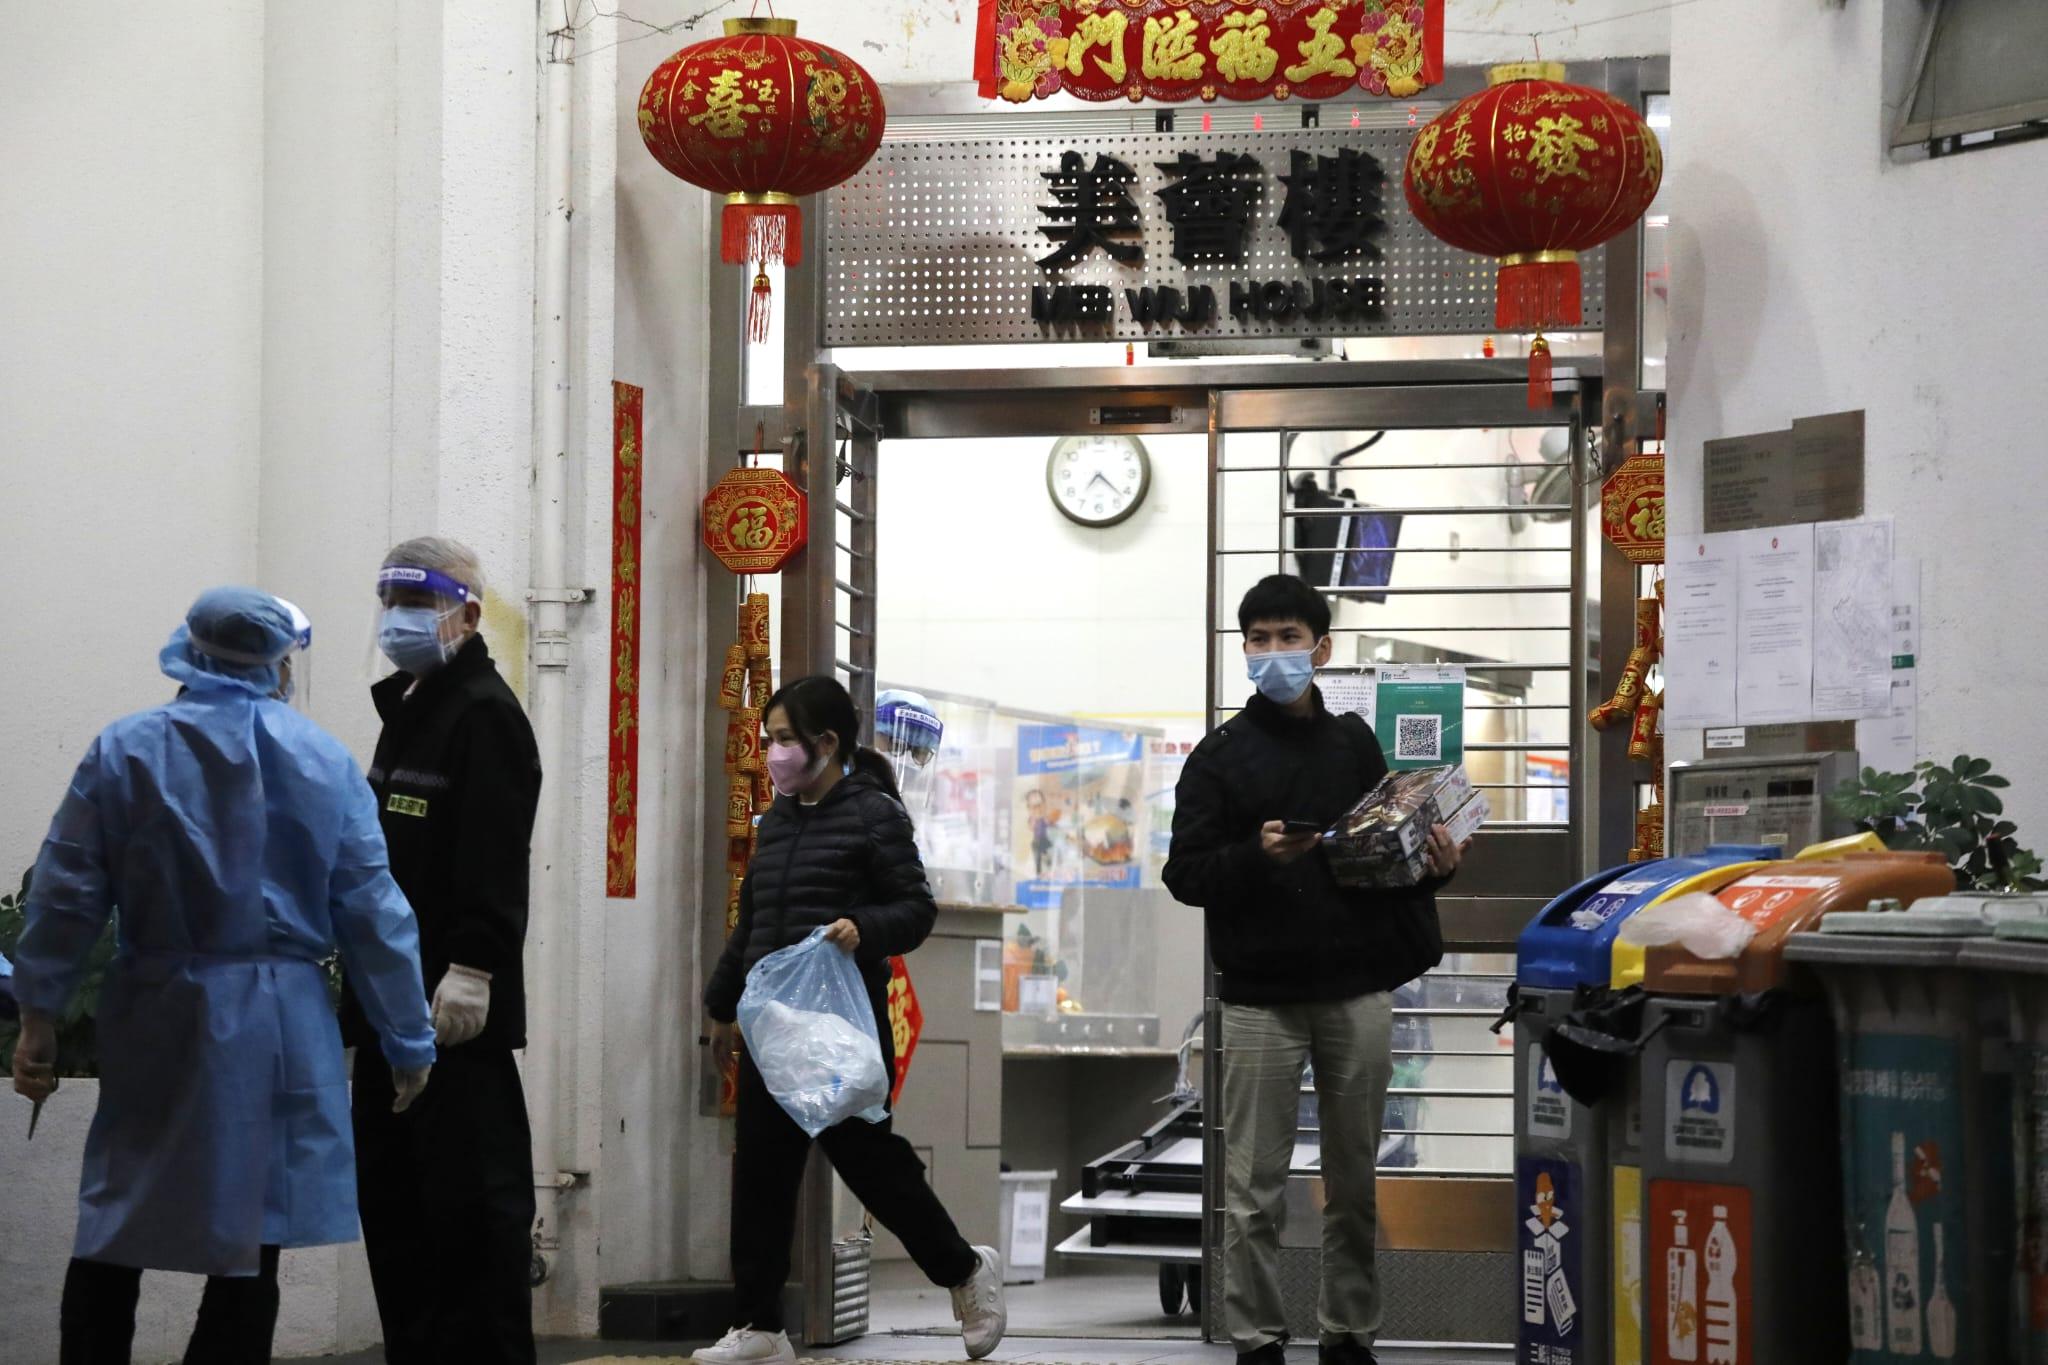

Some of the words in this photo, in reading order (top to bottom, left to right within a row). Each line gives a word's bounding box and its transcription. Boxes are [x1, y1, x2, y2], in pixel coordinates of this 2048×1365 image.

[687, 69, 761, 138] 喜
[1229, 277, 1387, 320] HOUSE
[730, 505, 774, 549] 福
[899, 709, 918, 719] Face
[919, 714, 939, 729] Shield
